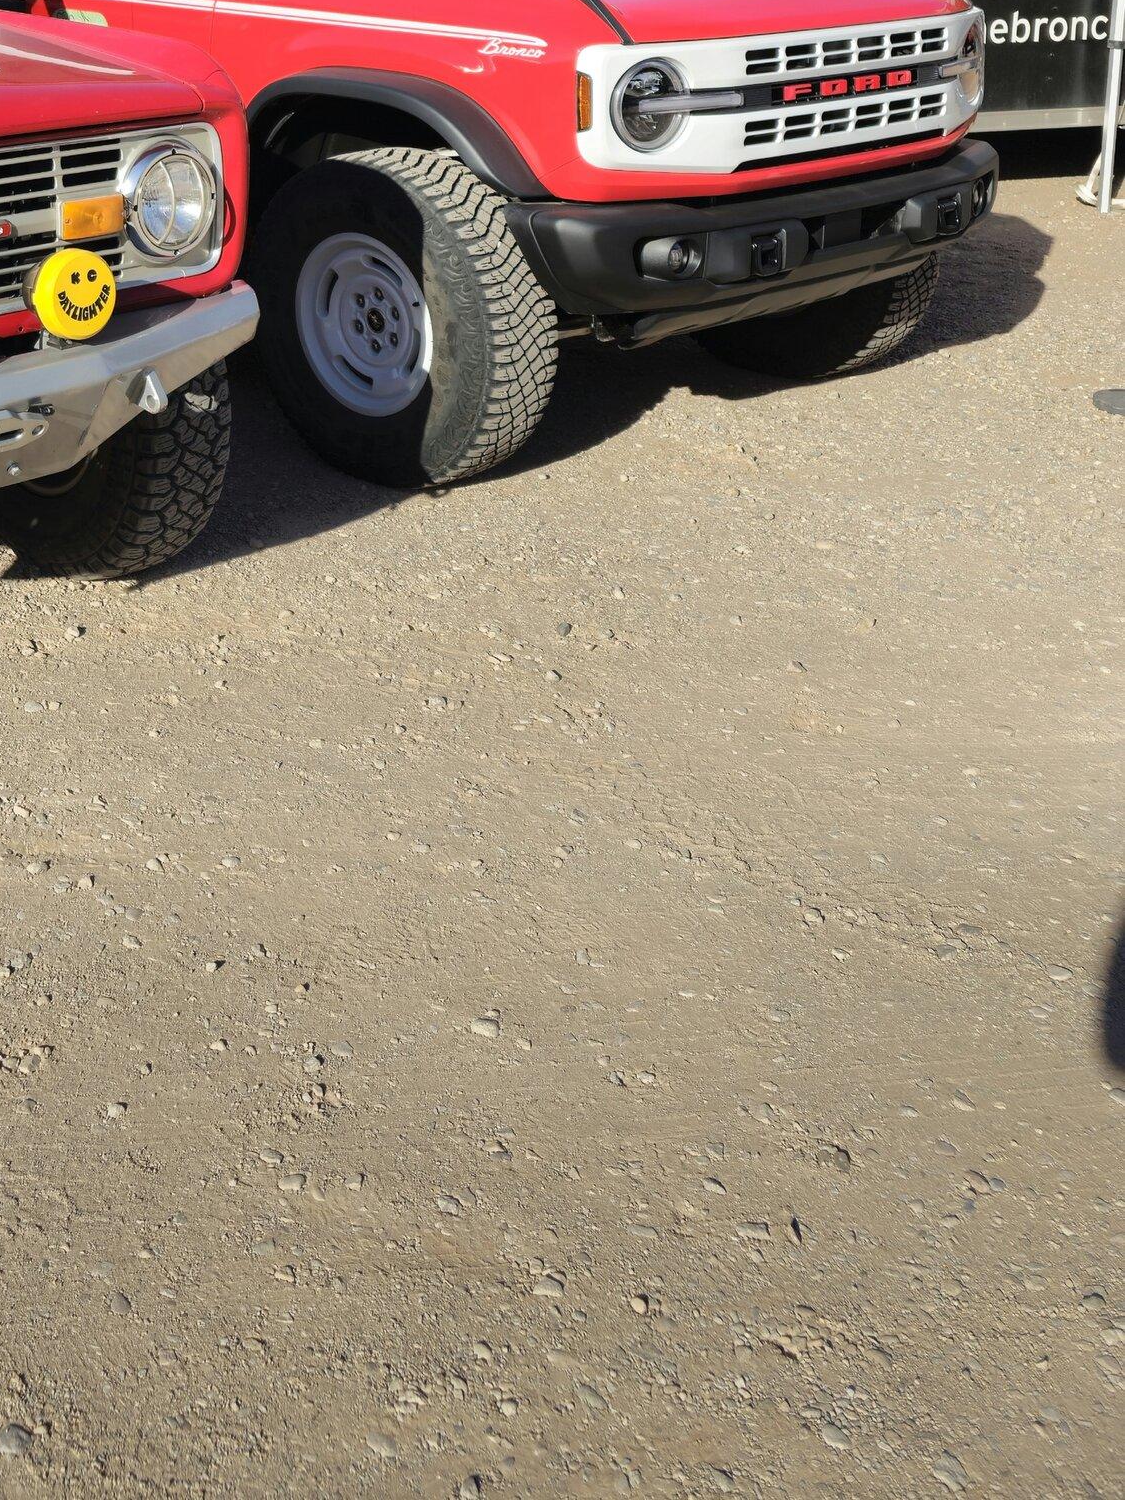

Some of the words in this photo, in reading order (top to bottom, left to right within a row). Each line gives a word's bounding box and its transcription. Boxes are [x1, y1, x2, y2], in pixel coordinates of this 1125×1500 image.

[478, 36, 546, 58] Bronco
[782, 69, 913, 103] FORD
[57, 283, 111, 322] DAYLIGHTER
